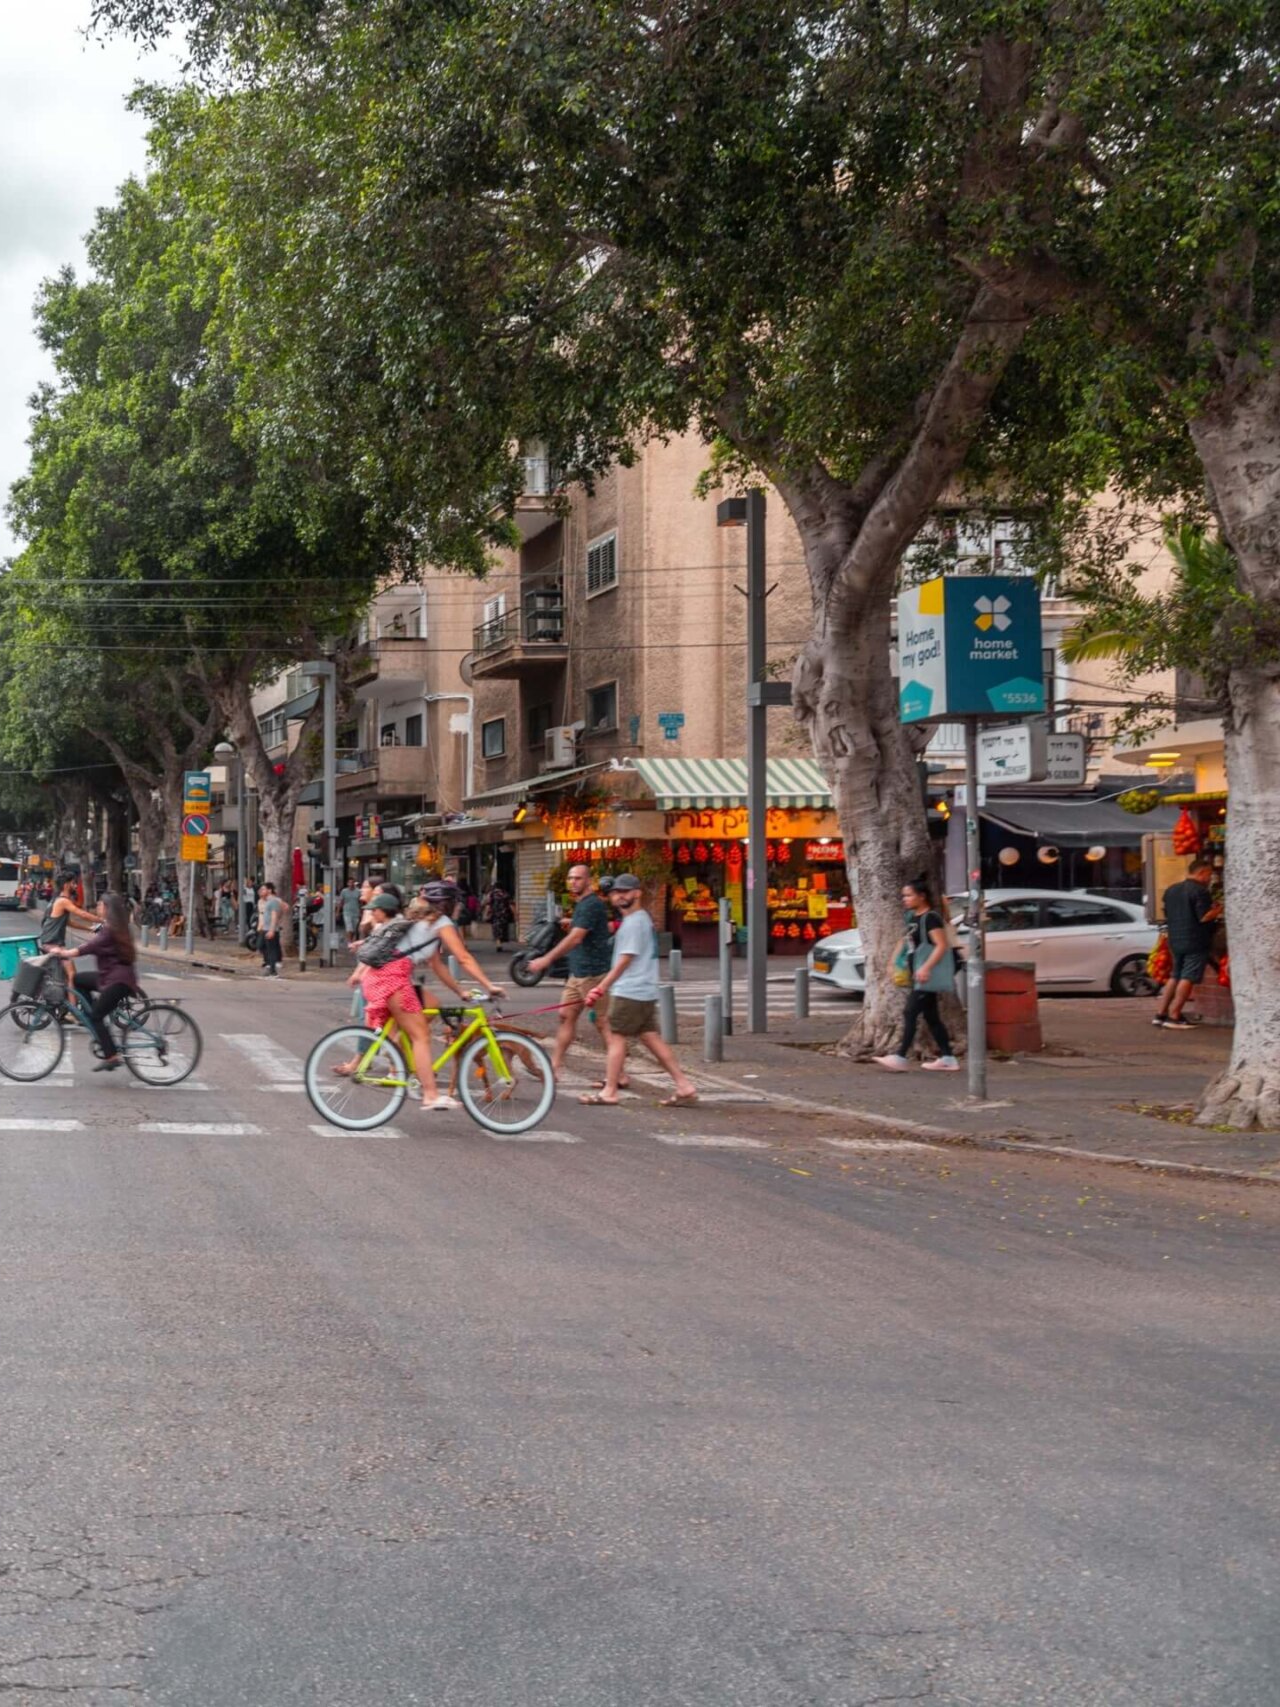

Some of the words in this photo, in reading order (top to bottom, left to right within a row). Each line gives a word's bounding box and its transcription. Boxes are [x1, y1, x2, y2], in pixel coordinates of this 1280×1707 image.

[906, 628, 935, 647] Home
[974, 637, 1013, 649] home
[902, 652, 917, 669] my
[969, 648, 1019, 660] market
